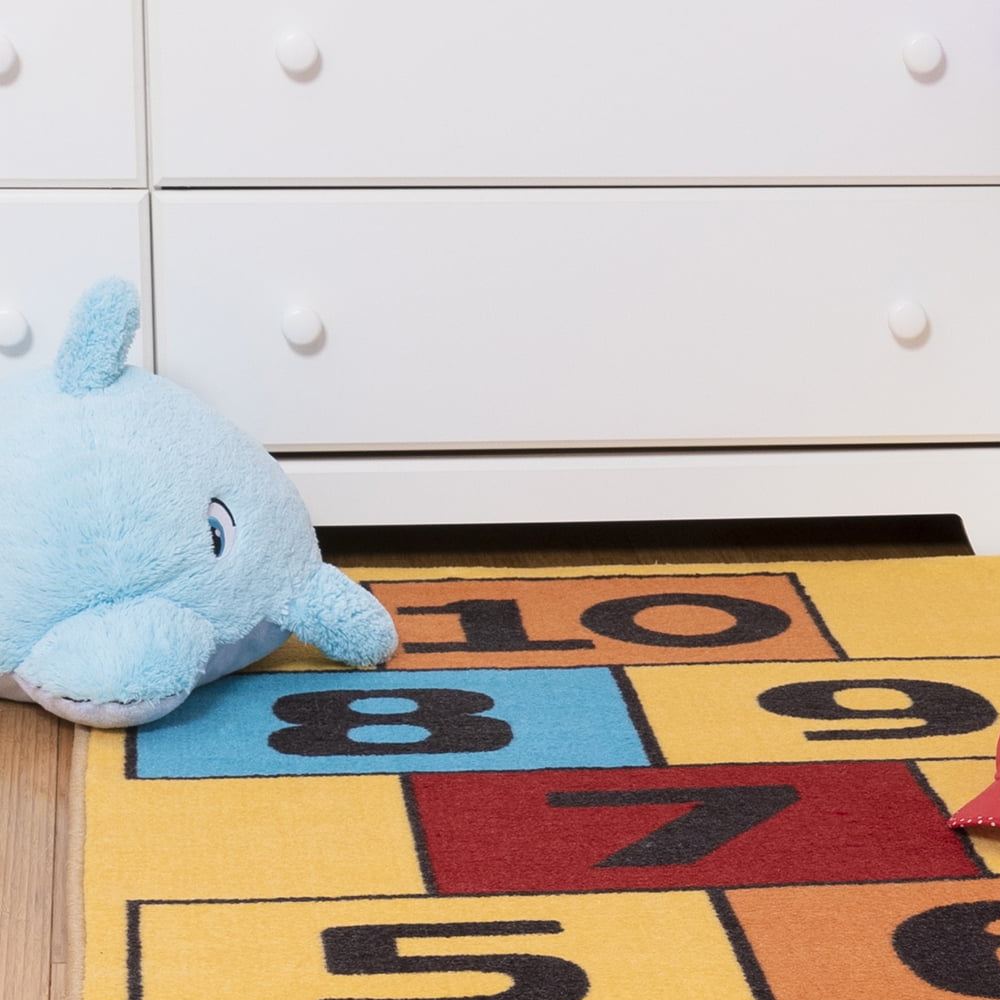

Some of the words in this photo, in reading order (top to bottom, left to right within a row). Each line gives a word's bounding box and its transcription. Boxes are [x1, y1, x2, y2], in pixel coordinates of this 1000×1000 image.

[396, 593, 792, 653] 10
[267, 688, 514, 757] 8
[757, 678, 998, 741] 9
[546, 784, 801, 868] 7
